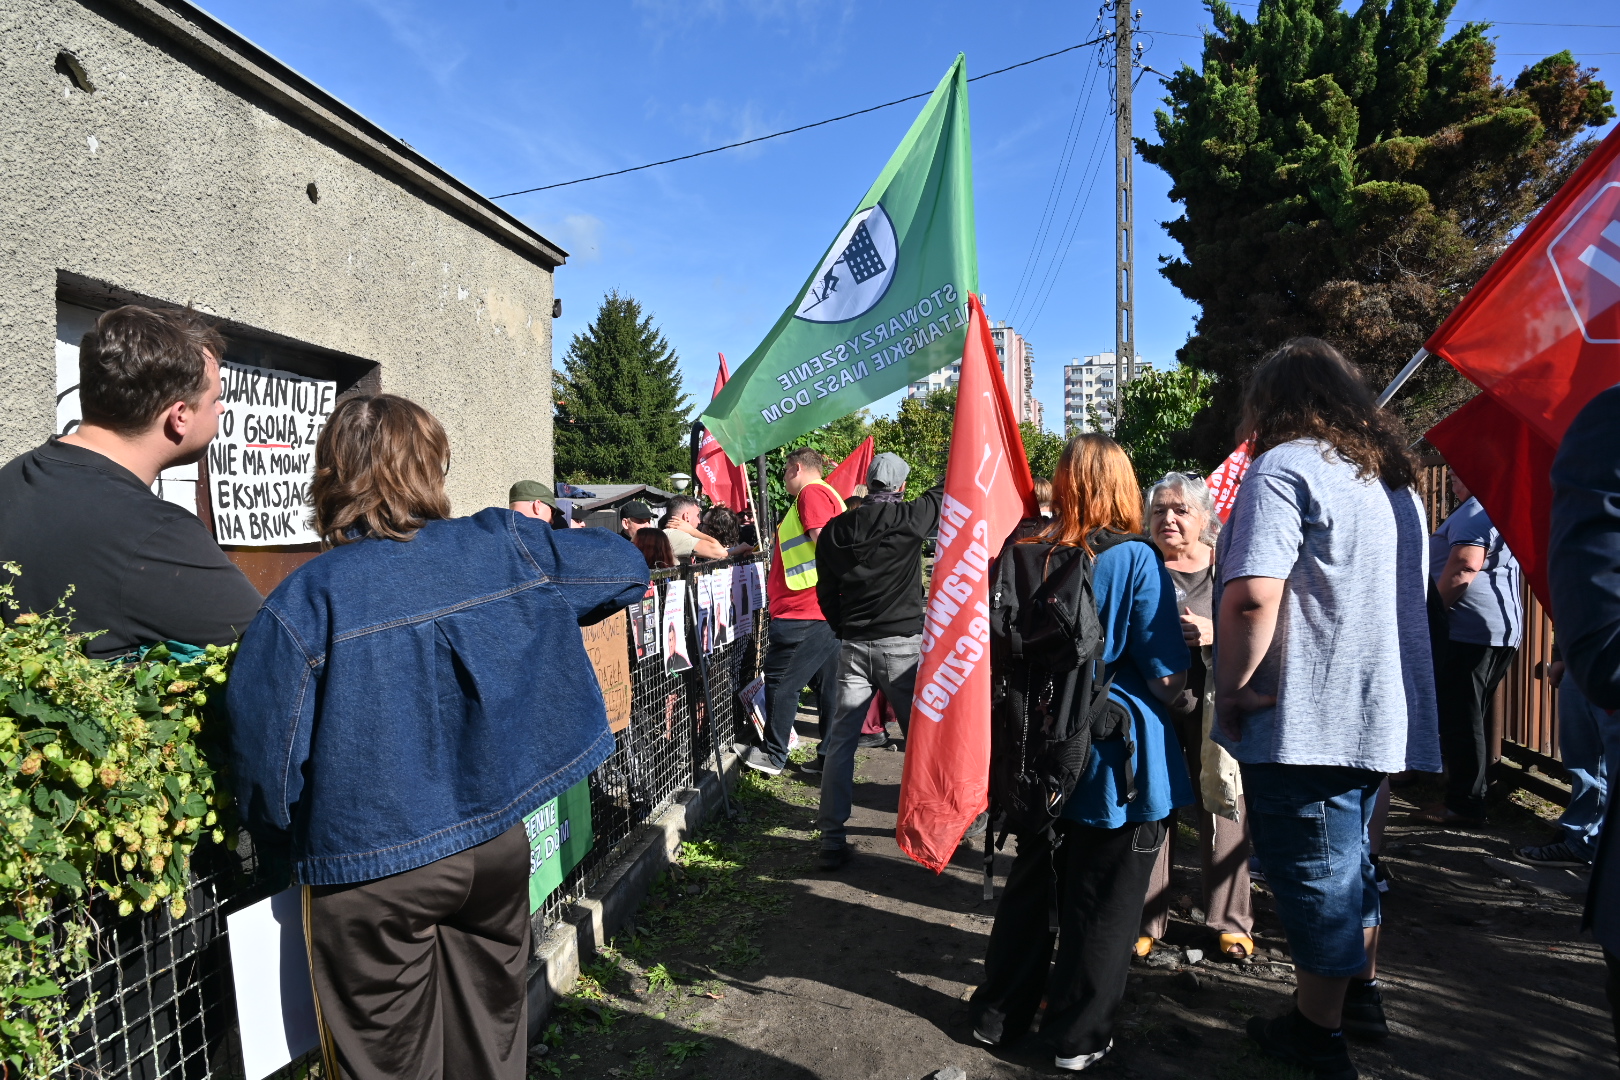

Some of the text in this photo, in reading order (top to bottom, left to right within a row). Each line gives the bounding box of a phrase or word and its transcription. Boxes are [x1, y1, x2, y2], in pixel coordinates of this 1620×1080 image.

[209, 443, 310, 476] NIE MA MOWY
[218, 513, 246, 540] NA
[545, 818, 570, 860] DOM
